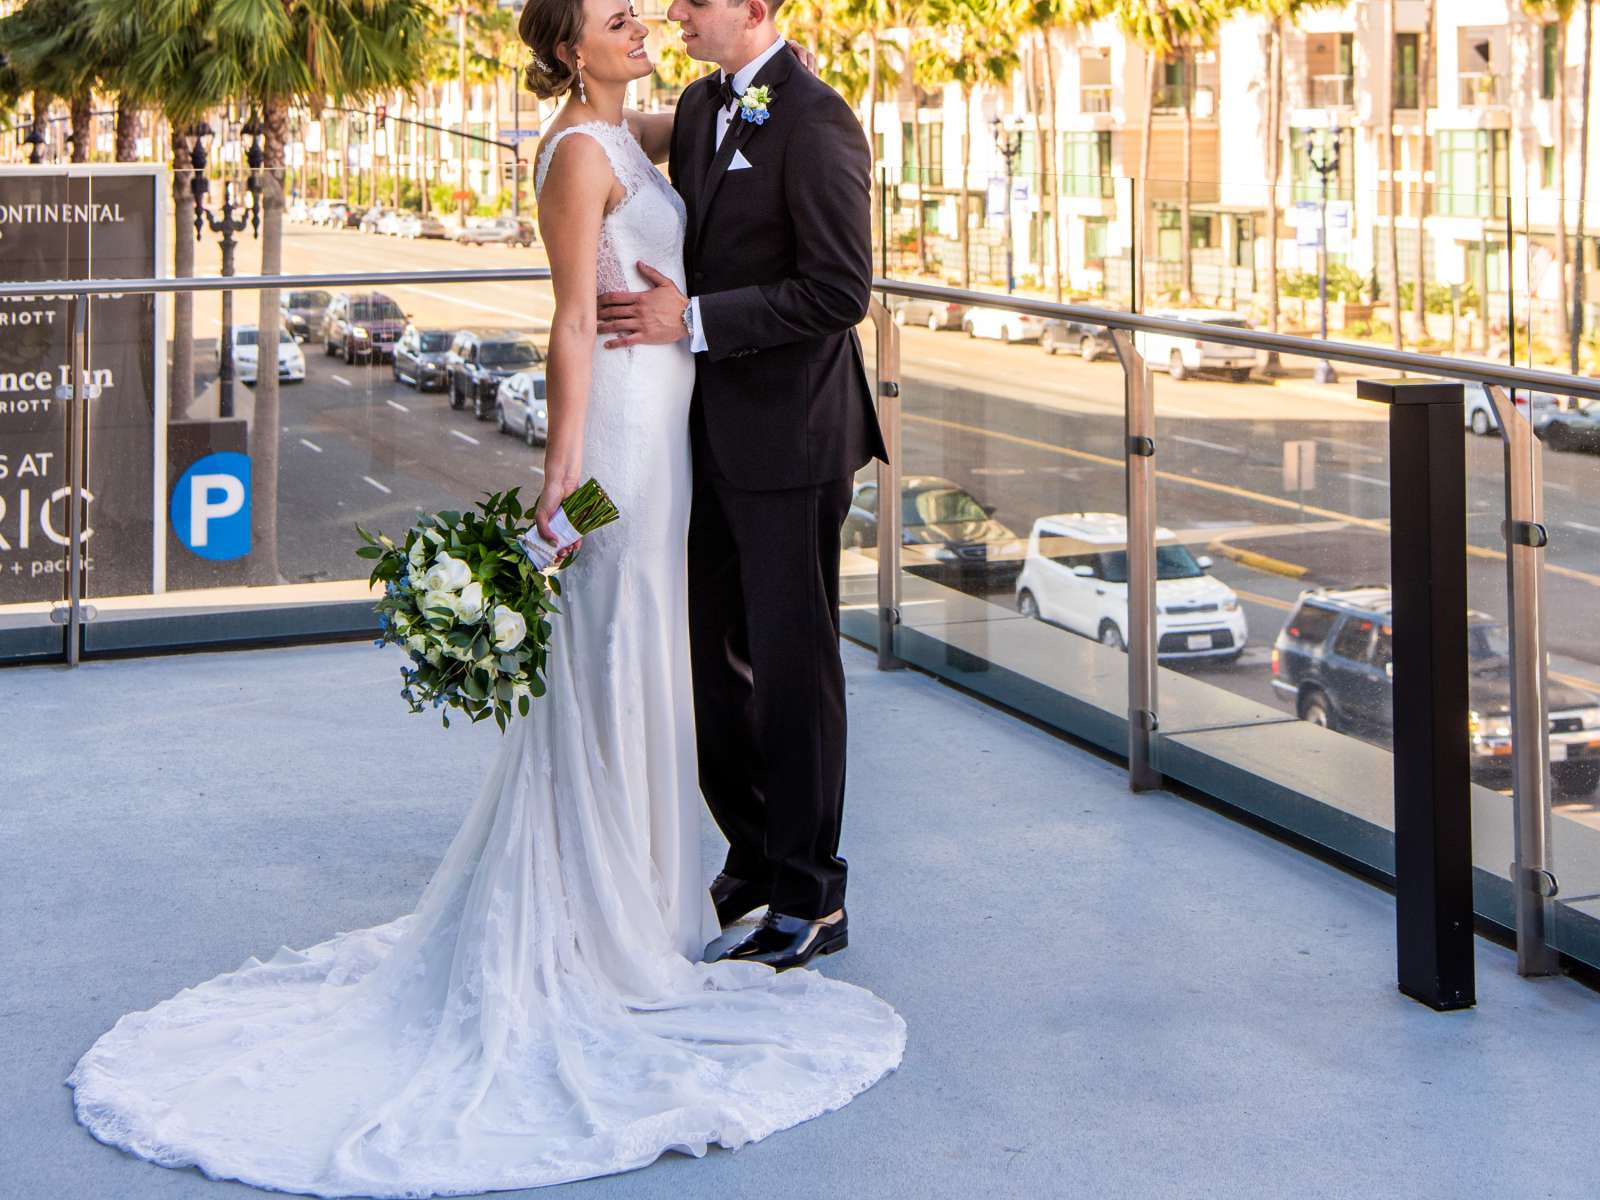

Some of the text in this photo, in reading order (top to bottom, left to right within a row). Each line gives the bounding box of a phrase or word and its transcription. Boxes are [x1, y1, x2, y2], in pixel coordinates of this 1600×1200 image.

[17, 452, 54, 478] AT
[190, 473, 245, 547] P
[31, 553, 95, 578] paciic
